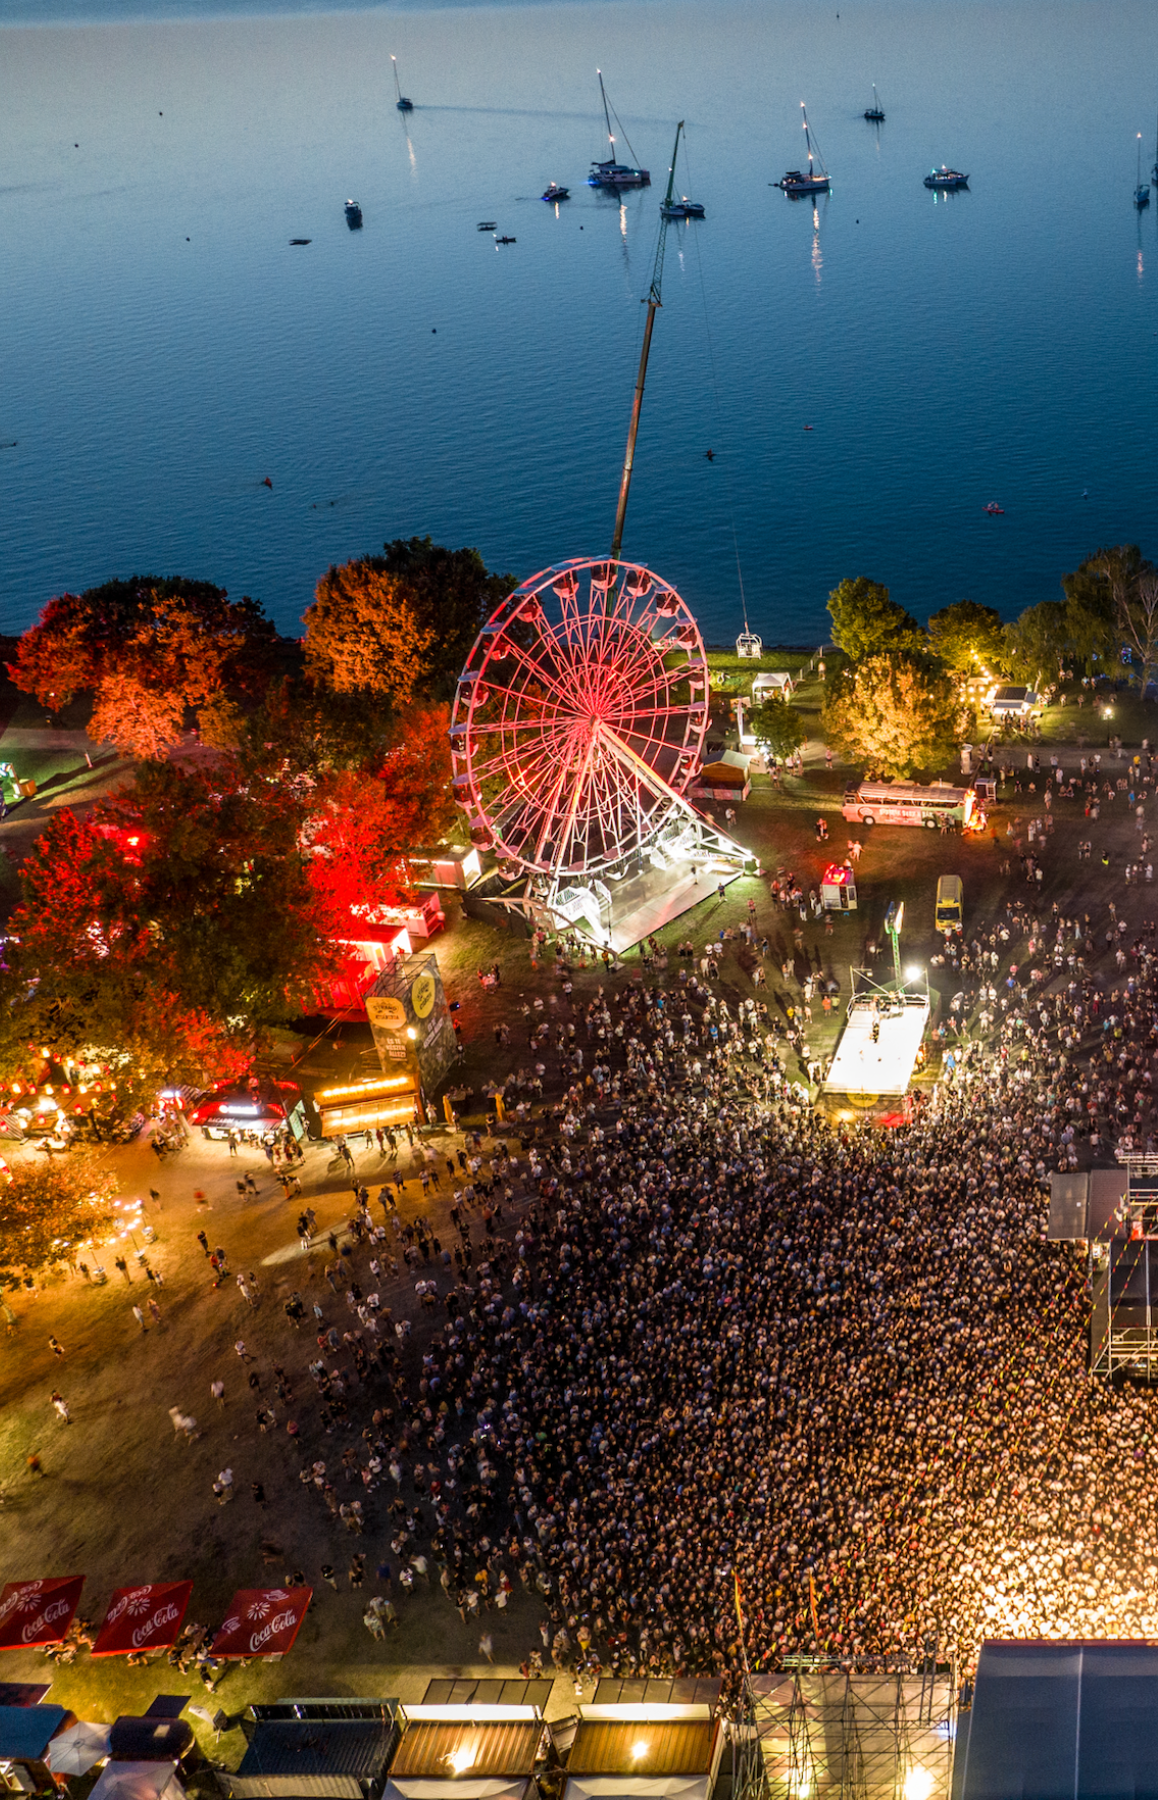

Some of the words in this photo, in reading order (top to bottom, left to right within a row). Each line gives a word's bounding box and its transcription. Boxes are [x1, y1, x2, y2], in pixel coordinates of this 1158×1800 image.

[22, 1598, 70, 1643] Coca-Cola
[132, 1602, 179, 1648] Coca-Cola
[250, 1609, 297, 1652] Coca-Cola
